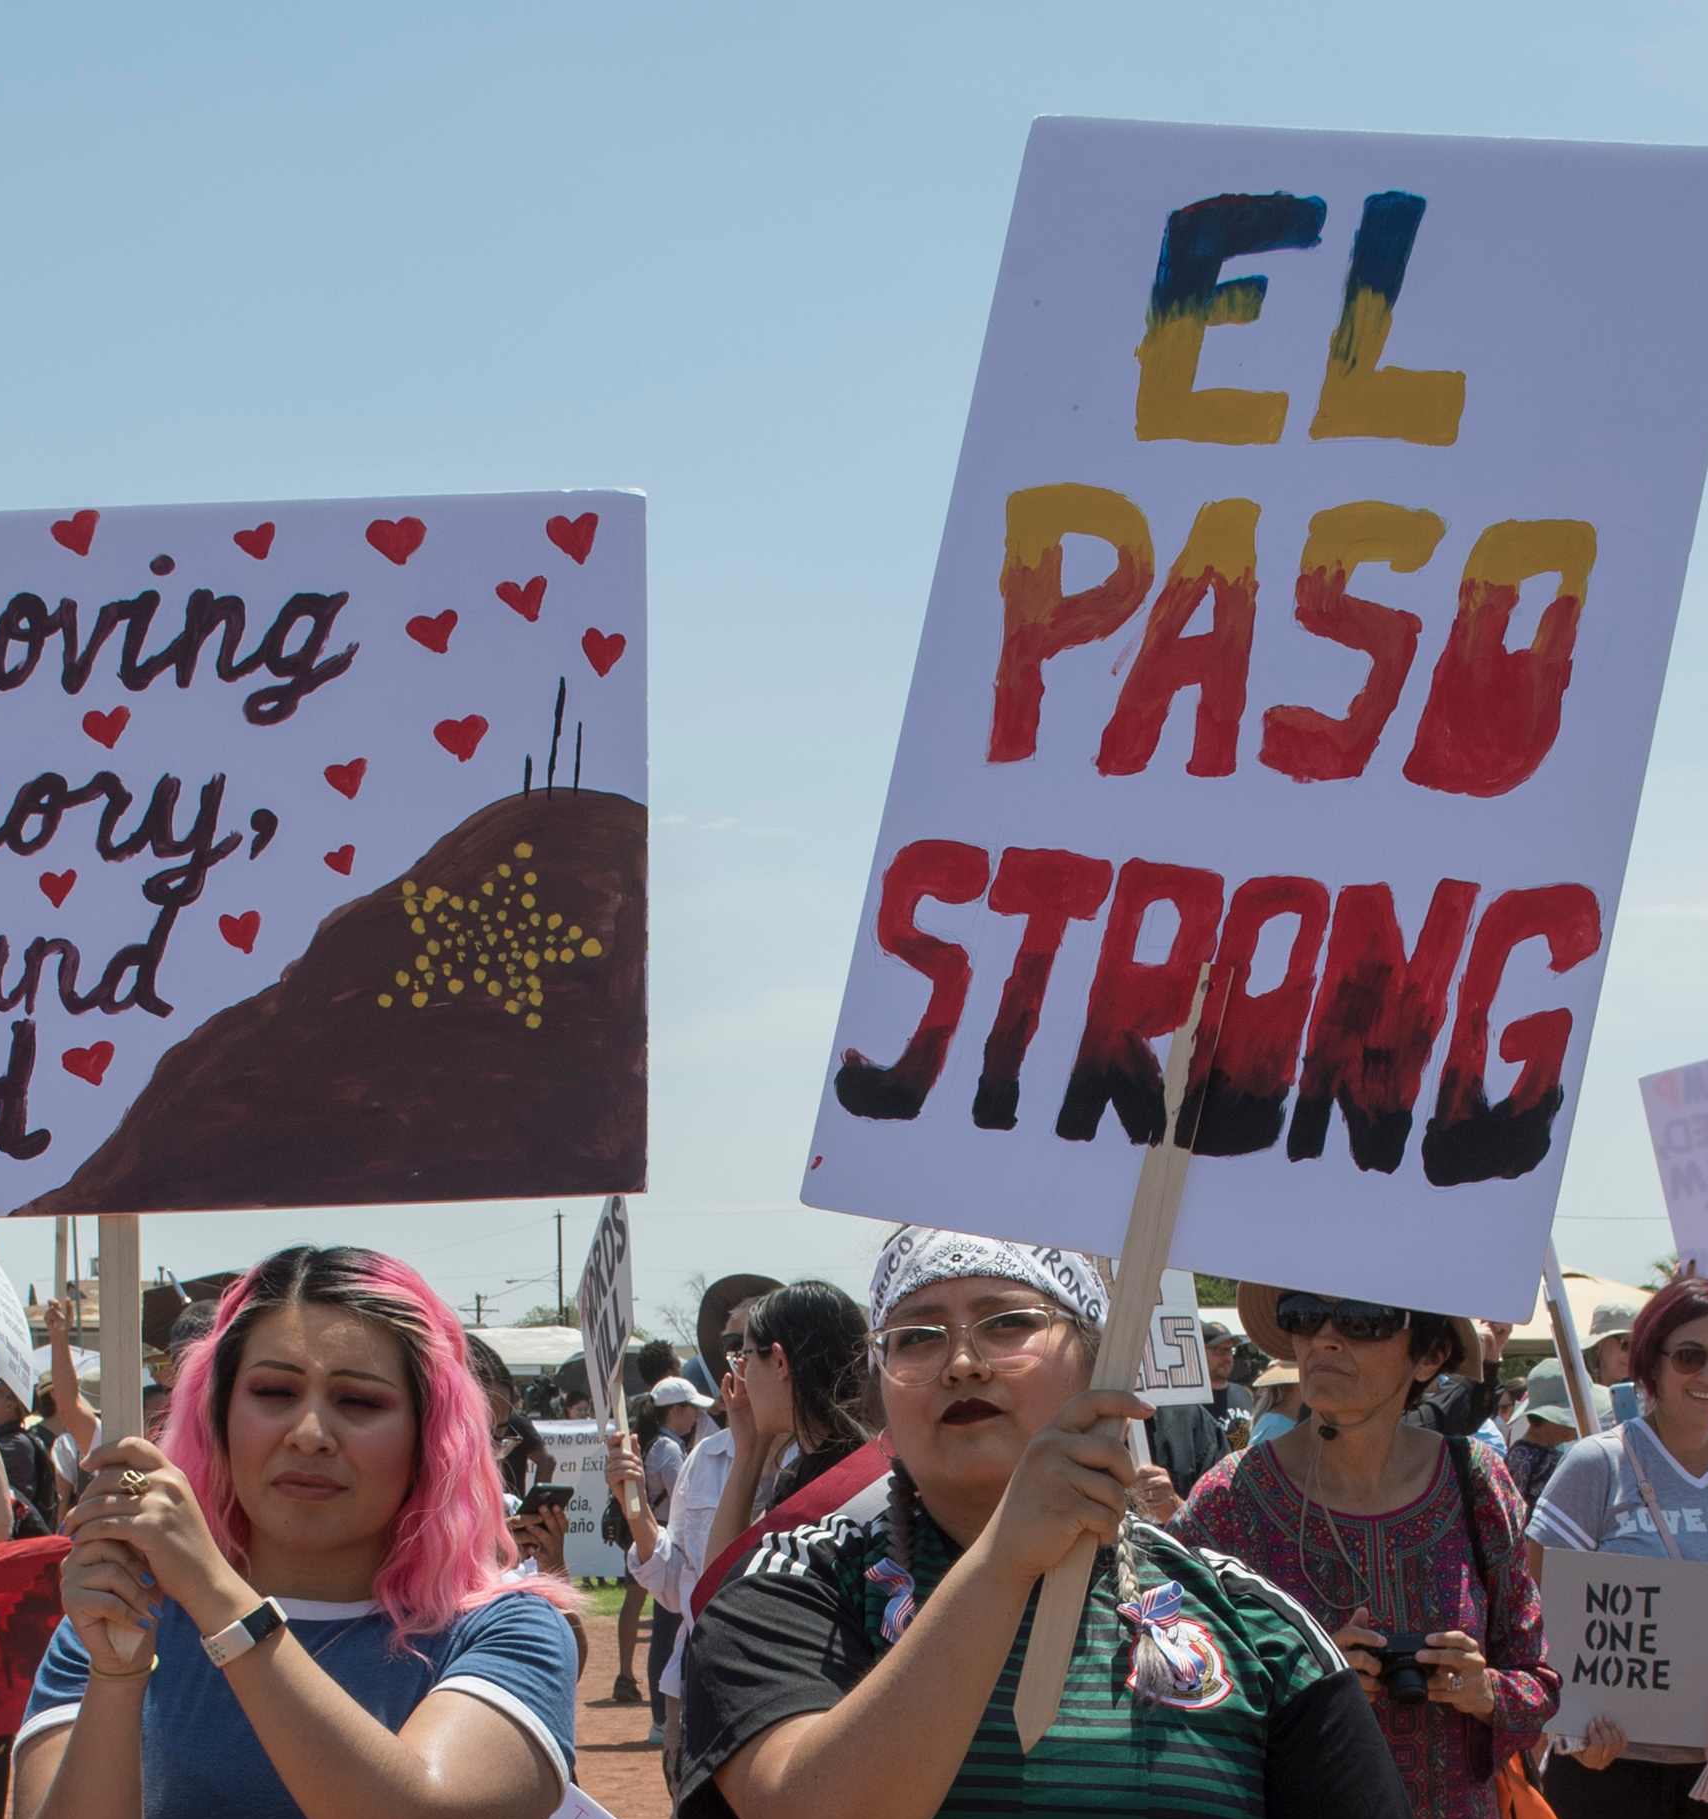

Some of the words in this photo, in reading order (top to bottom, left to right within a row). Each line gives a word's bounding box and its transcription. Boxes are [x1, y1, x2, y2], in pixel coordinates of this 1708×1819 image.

[1134, 191, 1466, 445] EL
[986, 483, 1597, 798] PASO
[834, 839, 1603, 1187] STRONG
[1571, 1653, 1670, 1691] MORE
[1584, 1620, 1658, 1655] ONE
[1586, 1582, 1660, 1618] NOT
